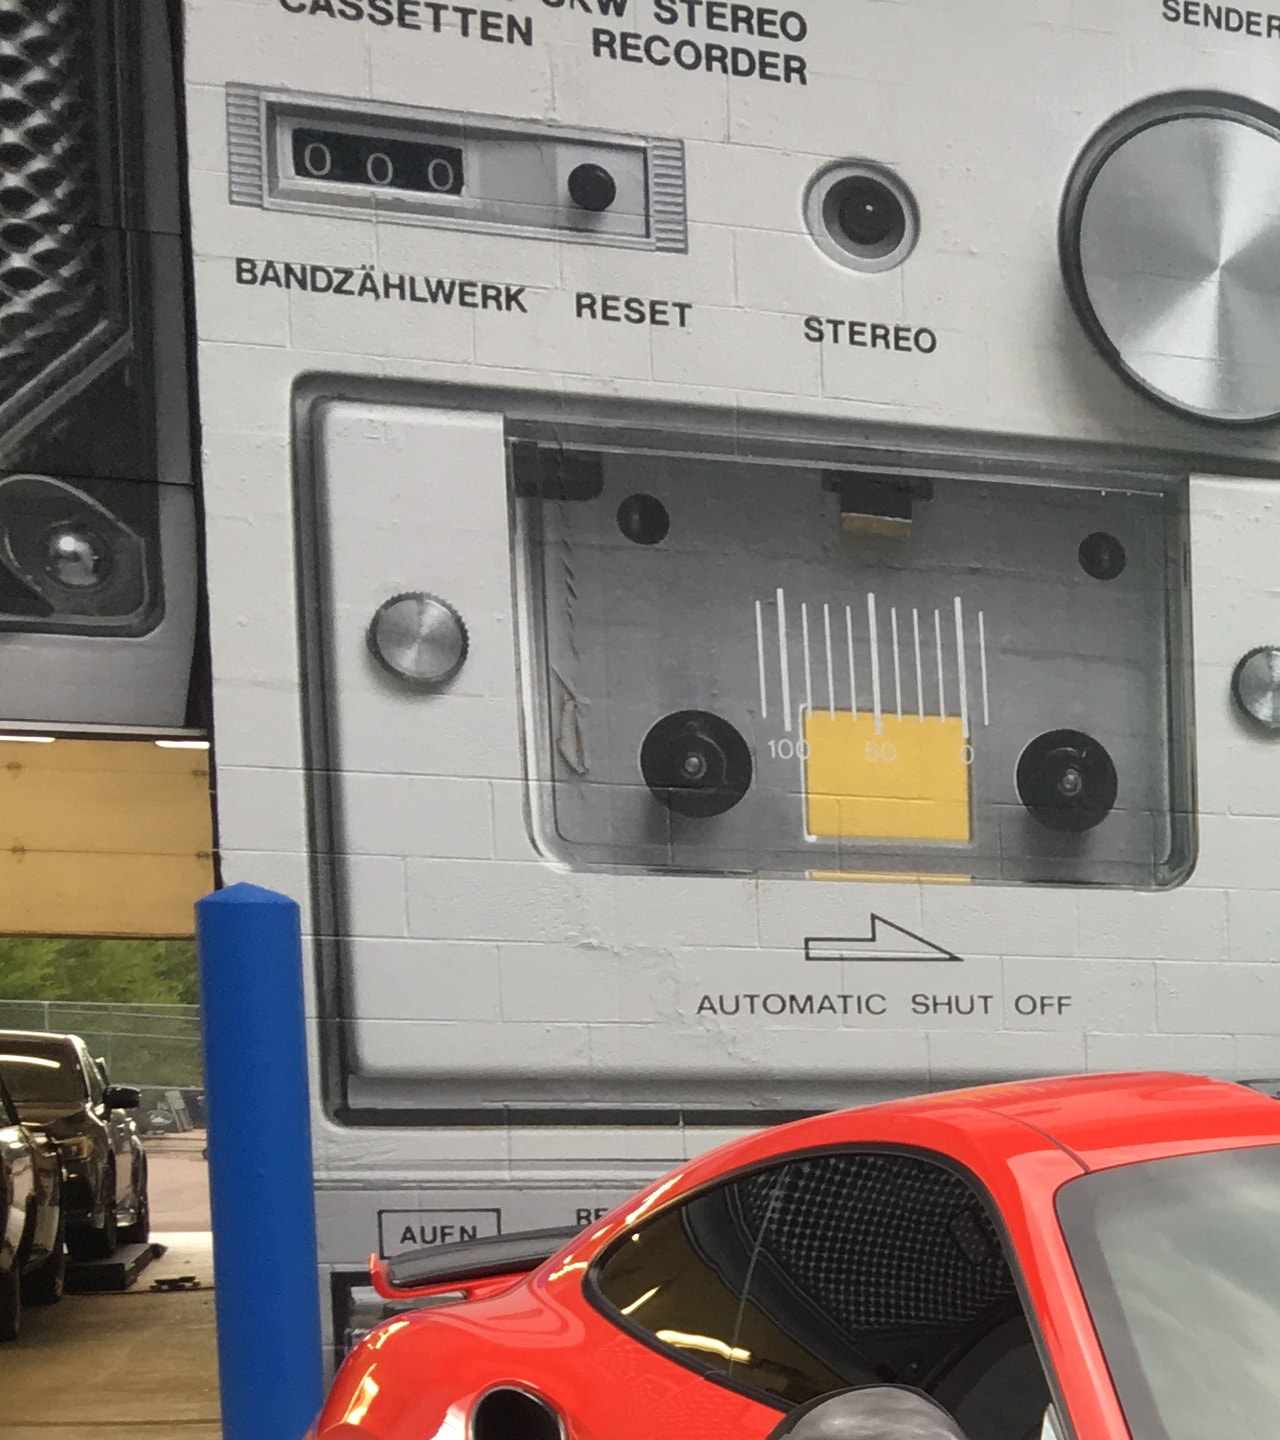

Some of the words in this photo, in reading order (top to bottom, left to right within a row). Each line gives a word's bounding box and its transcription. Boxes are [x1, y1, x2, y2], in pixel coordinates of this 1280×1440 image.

[653, 0, 807, 42] STEREO
[592, 27, 807, 86] RECORDER
[235, 257, 528, 314] BANDZÄHLWERK
[575, 292, 693, 328] RESET
[803, 315, 938, 354] STEREO
[767, 738, 812, 760] 100
[865, 741, 897, 763] 50
[960, 744, 975, 765] 0
[696, 993, 887, 1016] AUTOMATIC
[911, 993, 994, 1016] SHUT
[1013, 993, 1072, 1016] OFF
[399, 1225, 477, 1245] AUFN
